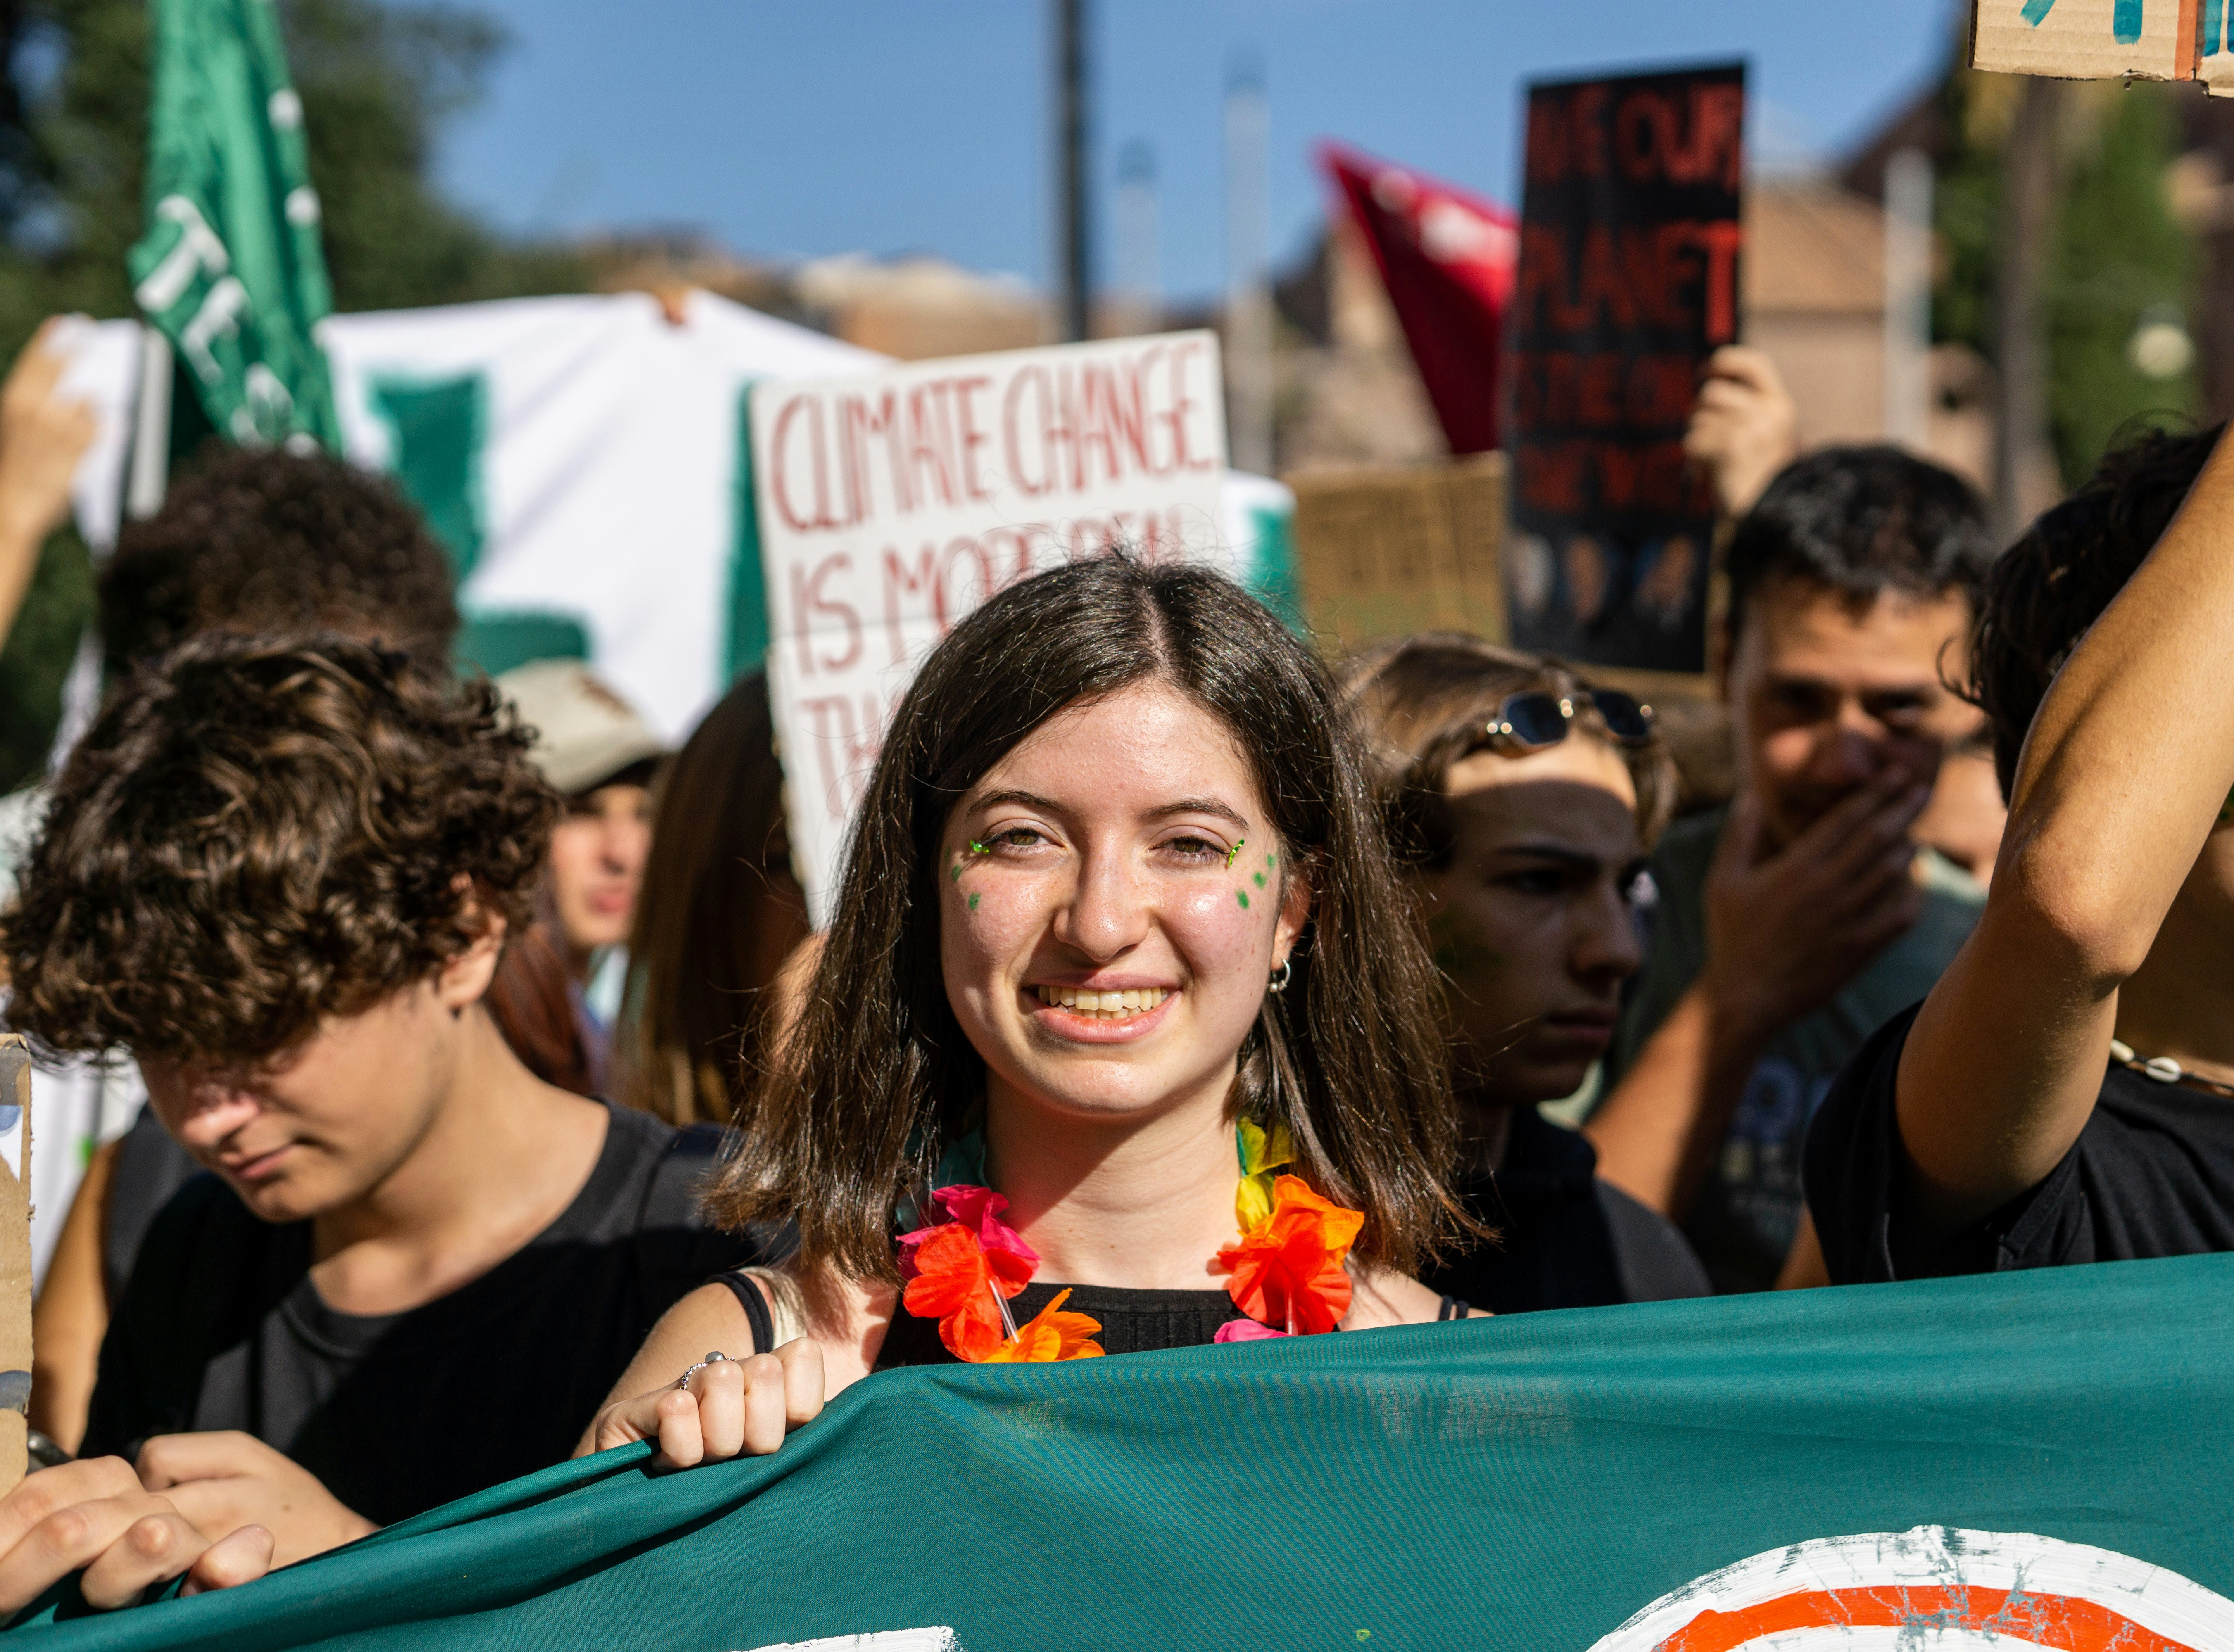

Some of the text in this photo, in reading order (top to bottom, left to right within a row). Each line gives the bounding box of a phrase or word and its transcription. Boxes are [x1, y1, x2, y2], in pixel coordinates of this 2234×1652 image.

[1515, 221, 1742, 345] PLANET
[770, 375, 992, 534] CLIMATE
[1001, 341, 1217, 498] CHANGE
[790, 549, 863, 677] IS
